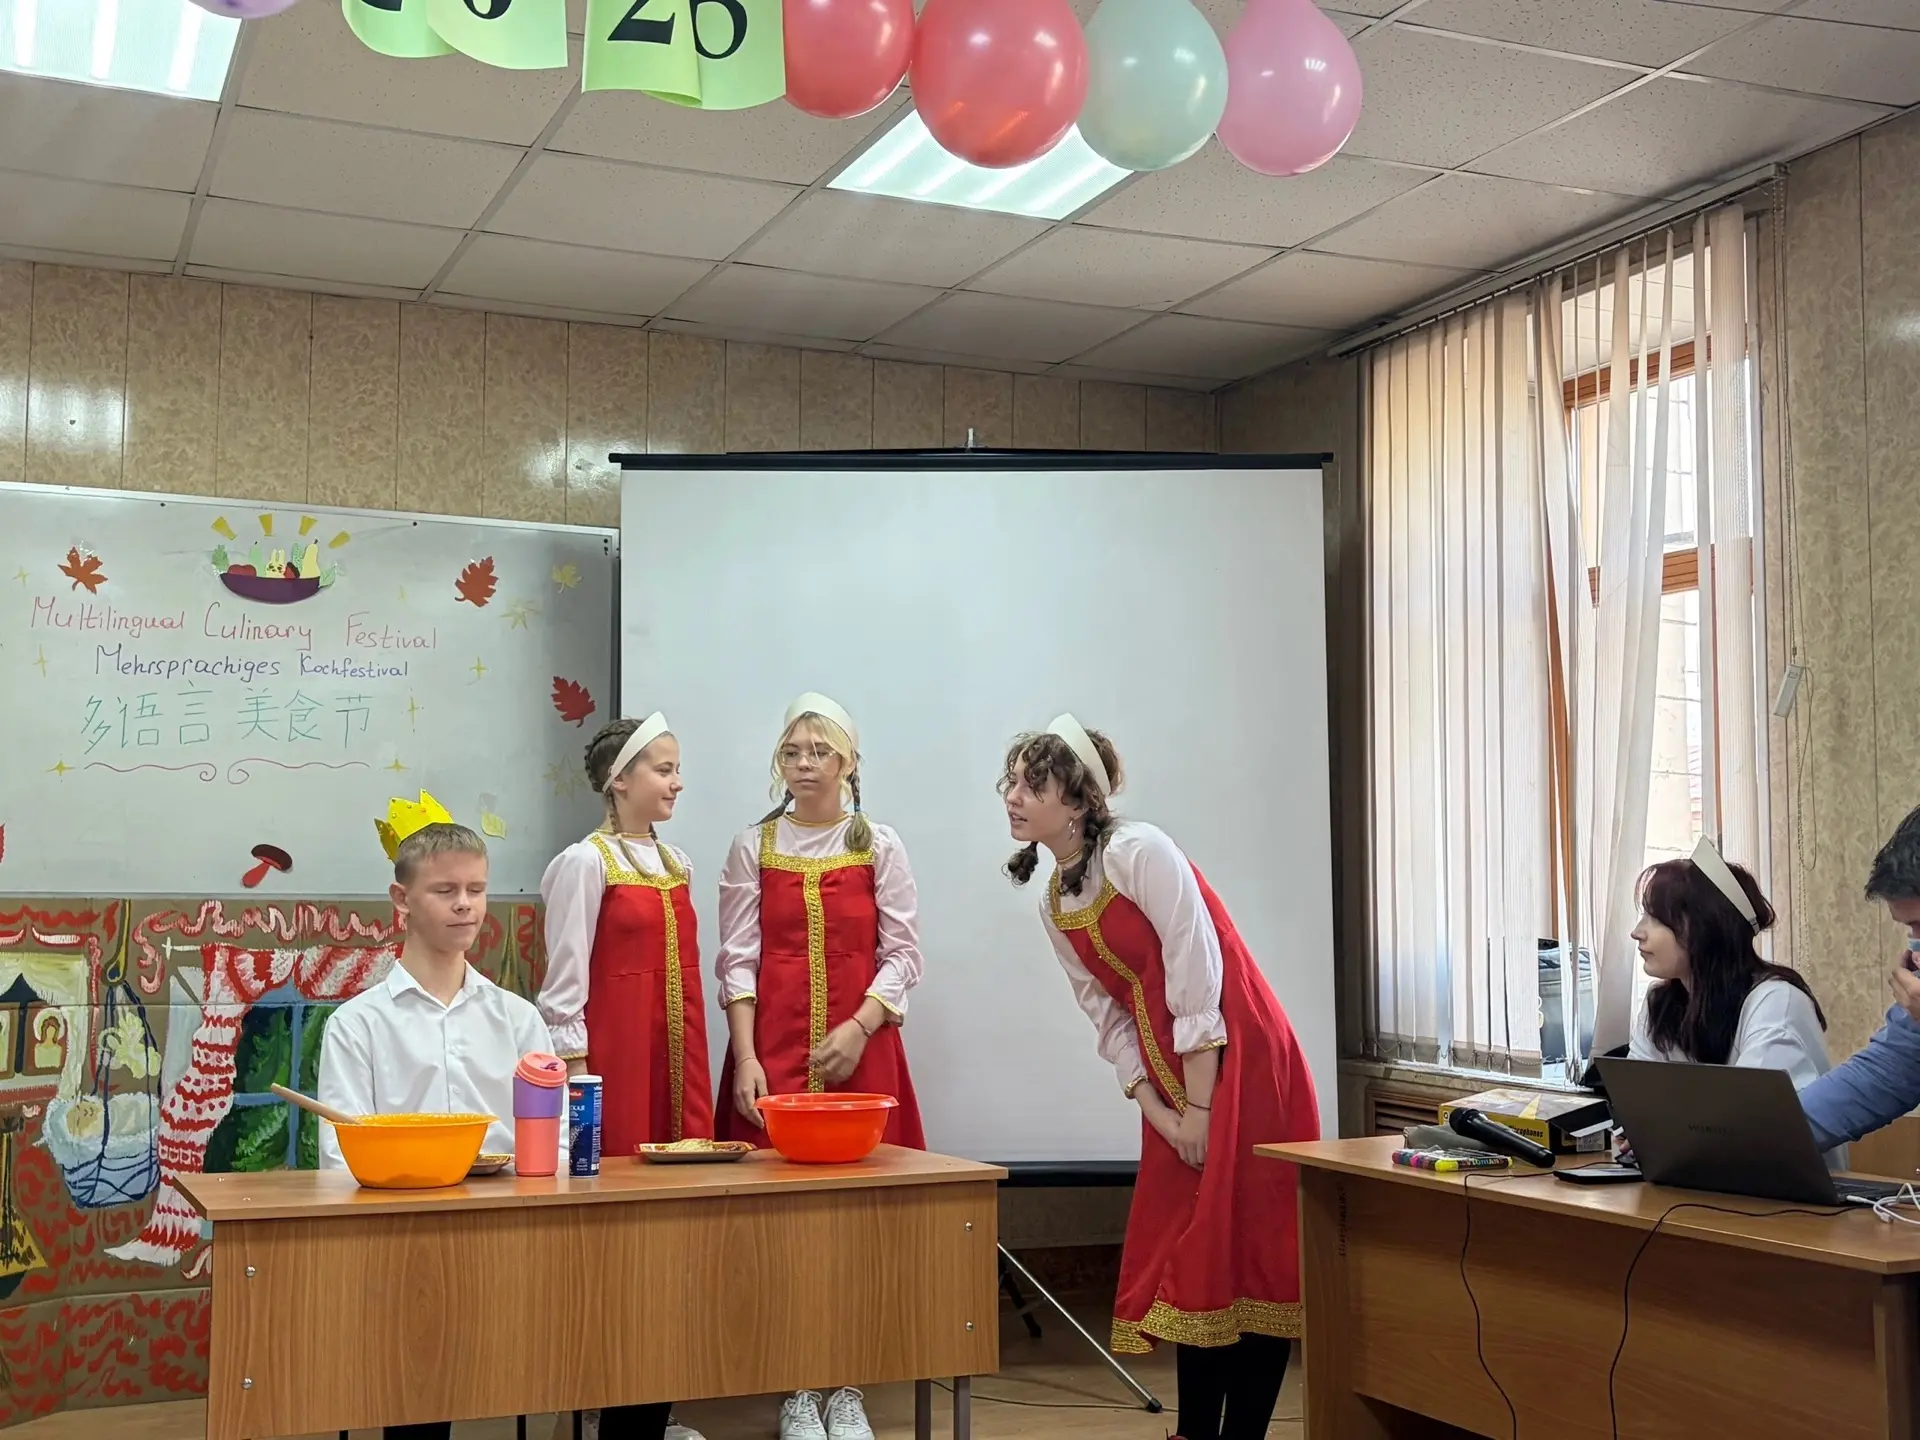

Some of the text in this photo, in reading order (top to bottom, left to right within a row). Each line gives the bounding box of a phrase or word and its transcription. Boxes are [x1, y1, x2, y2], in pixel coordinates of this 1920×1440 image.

[31, 596, 437, 651] Multilingual Culinary Festival
[95, 643, 408, 682] Mehrsprachiges Kochfestival
